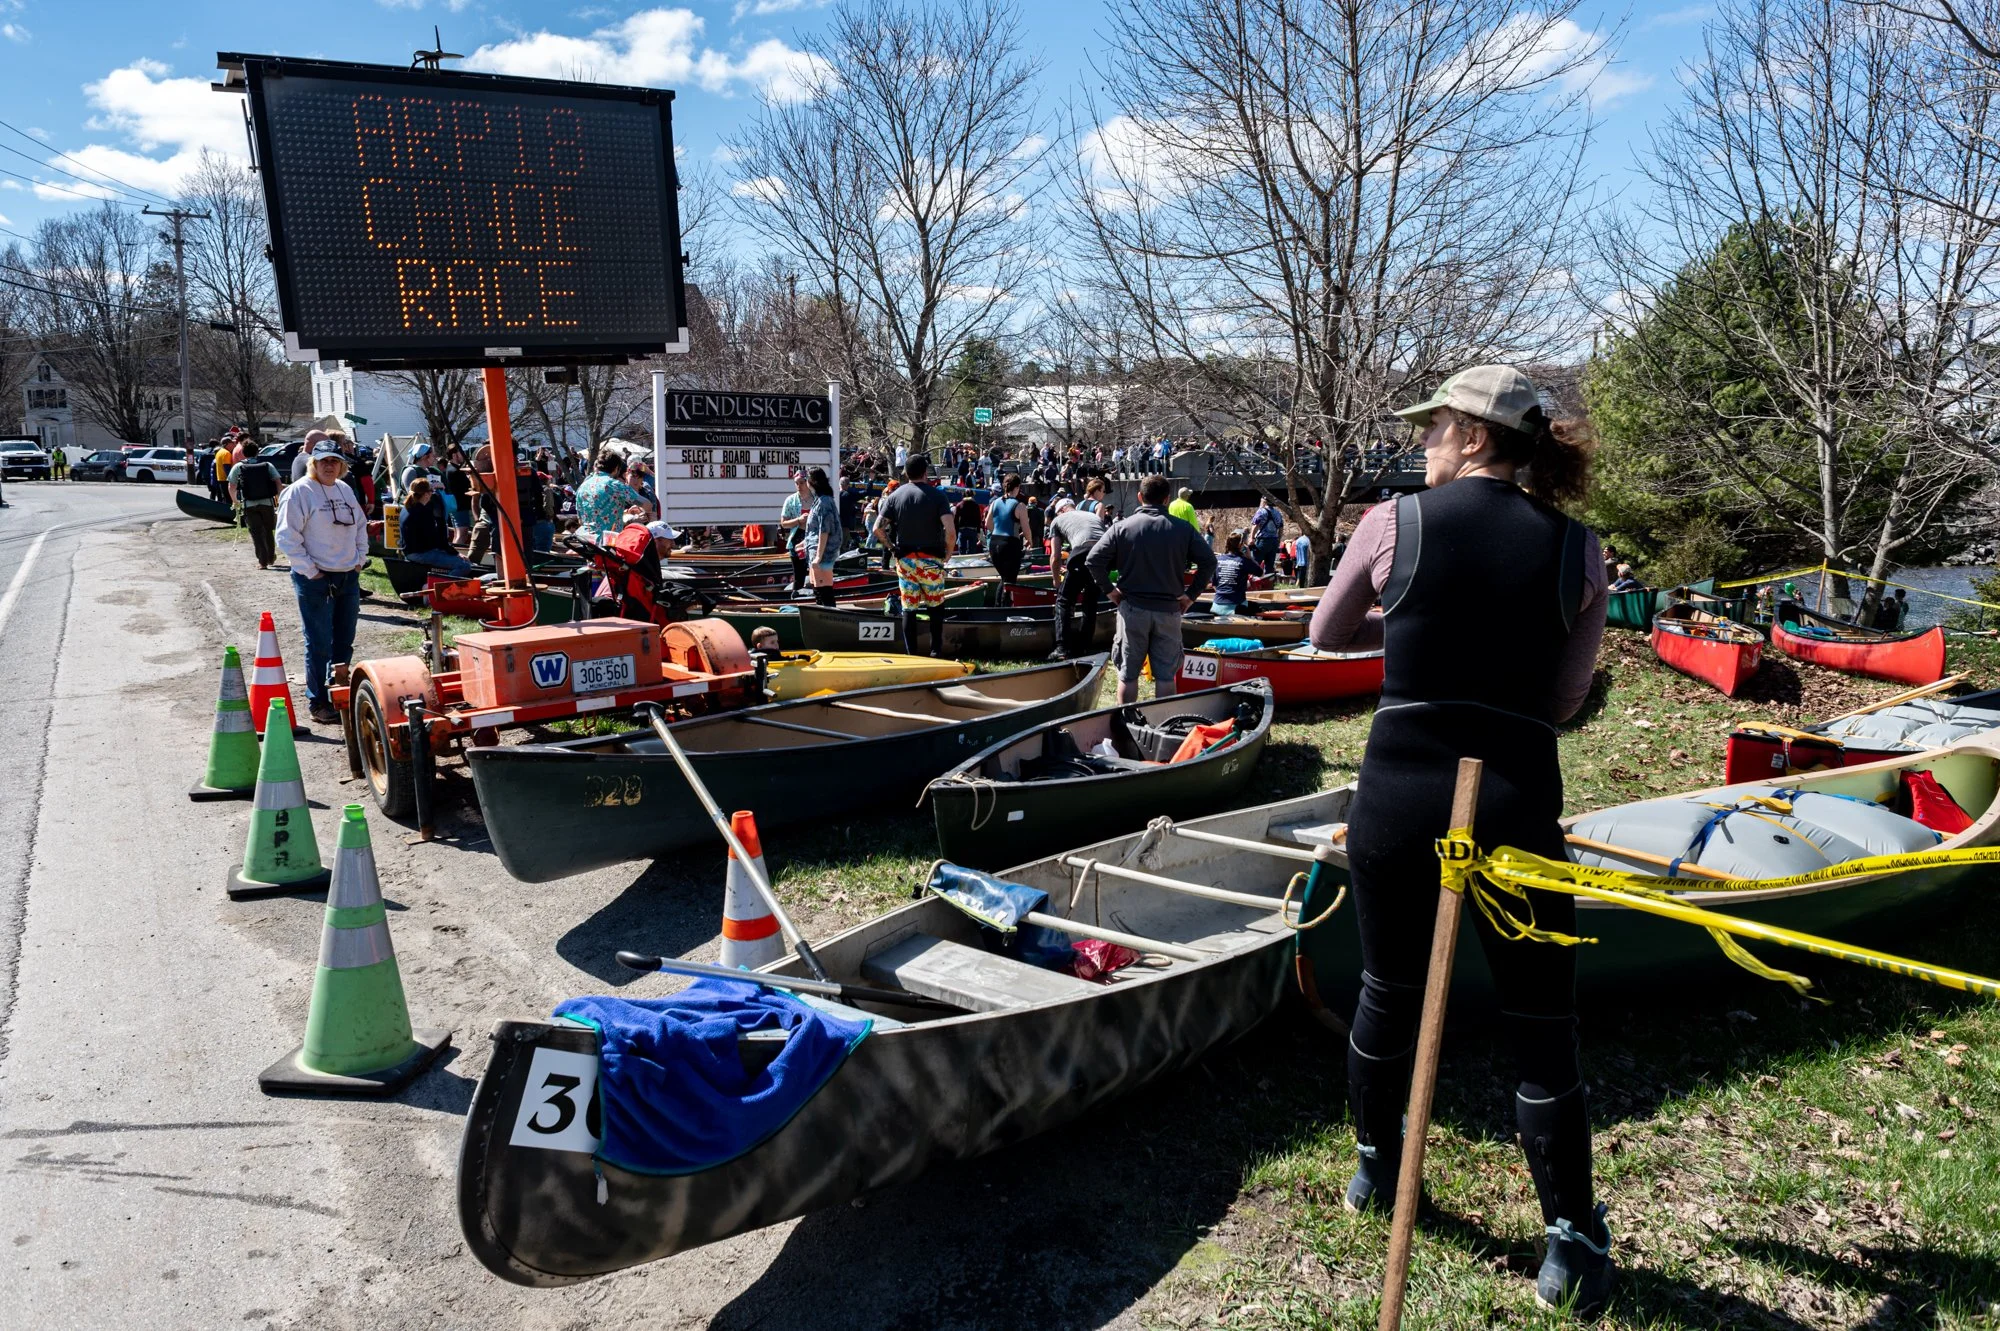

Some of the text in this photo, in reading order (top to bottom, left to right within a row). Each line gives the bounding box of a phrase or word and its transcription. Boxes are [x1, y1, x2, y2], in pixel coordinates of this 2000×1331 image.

[362, 177, 591, 251] CANOE
[396, 258, 579, 328] RACE
[673, 394, 823, 424] KENDUSKEAG
[724, 418, 761, 426] Incorporated
[705, 432, 795, 445] Community Events
[681, 449, 800, 464] SELECT BOARD MEETINGS
[690, 464, 705, 479] 1ST
[708, 464, 715, 478] &
[720, 464, 737, 478] 3RD
[745, 464, 769, 479] TUES.
[862, 626, 891, 638] 272
[592, 658, 615, 666] MAINE
[1184, 659, 1216, 677] 449
[536, 657, 563, 683] W
[589, 682, 621, 690] MUNICIPAL
